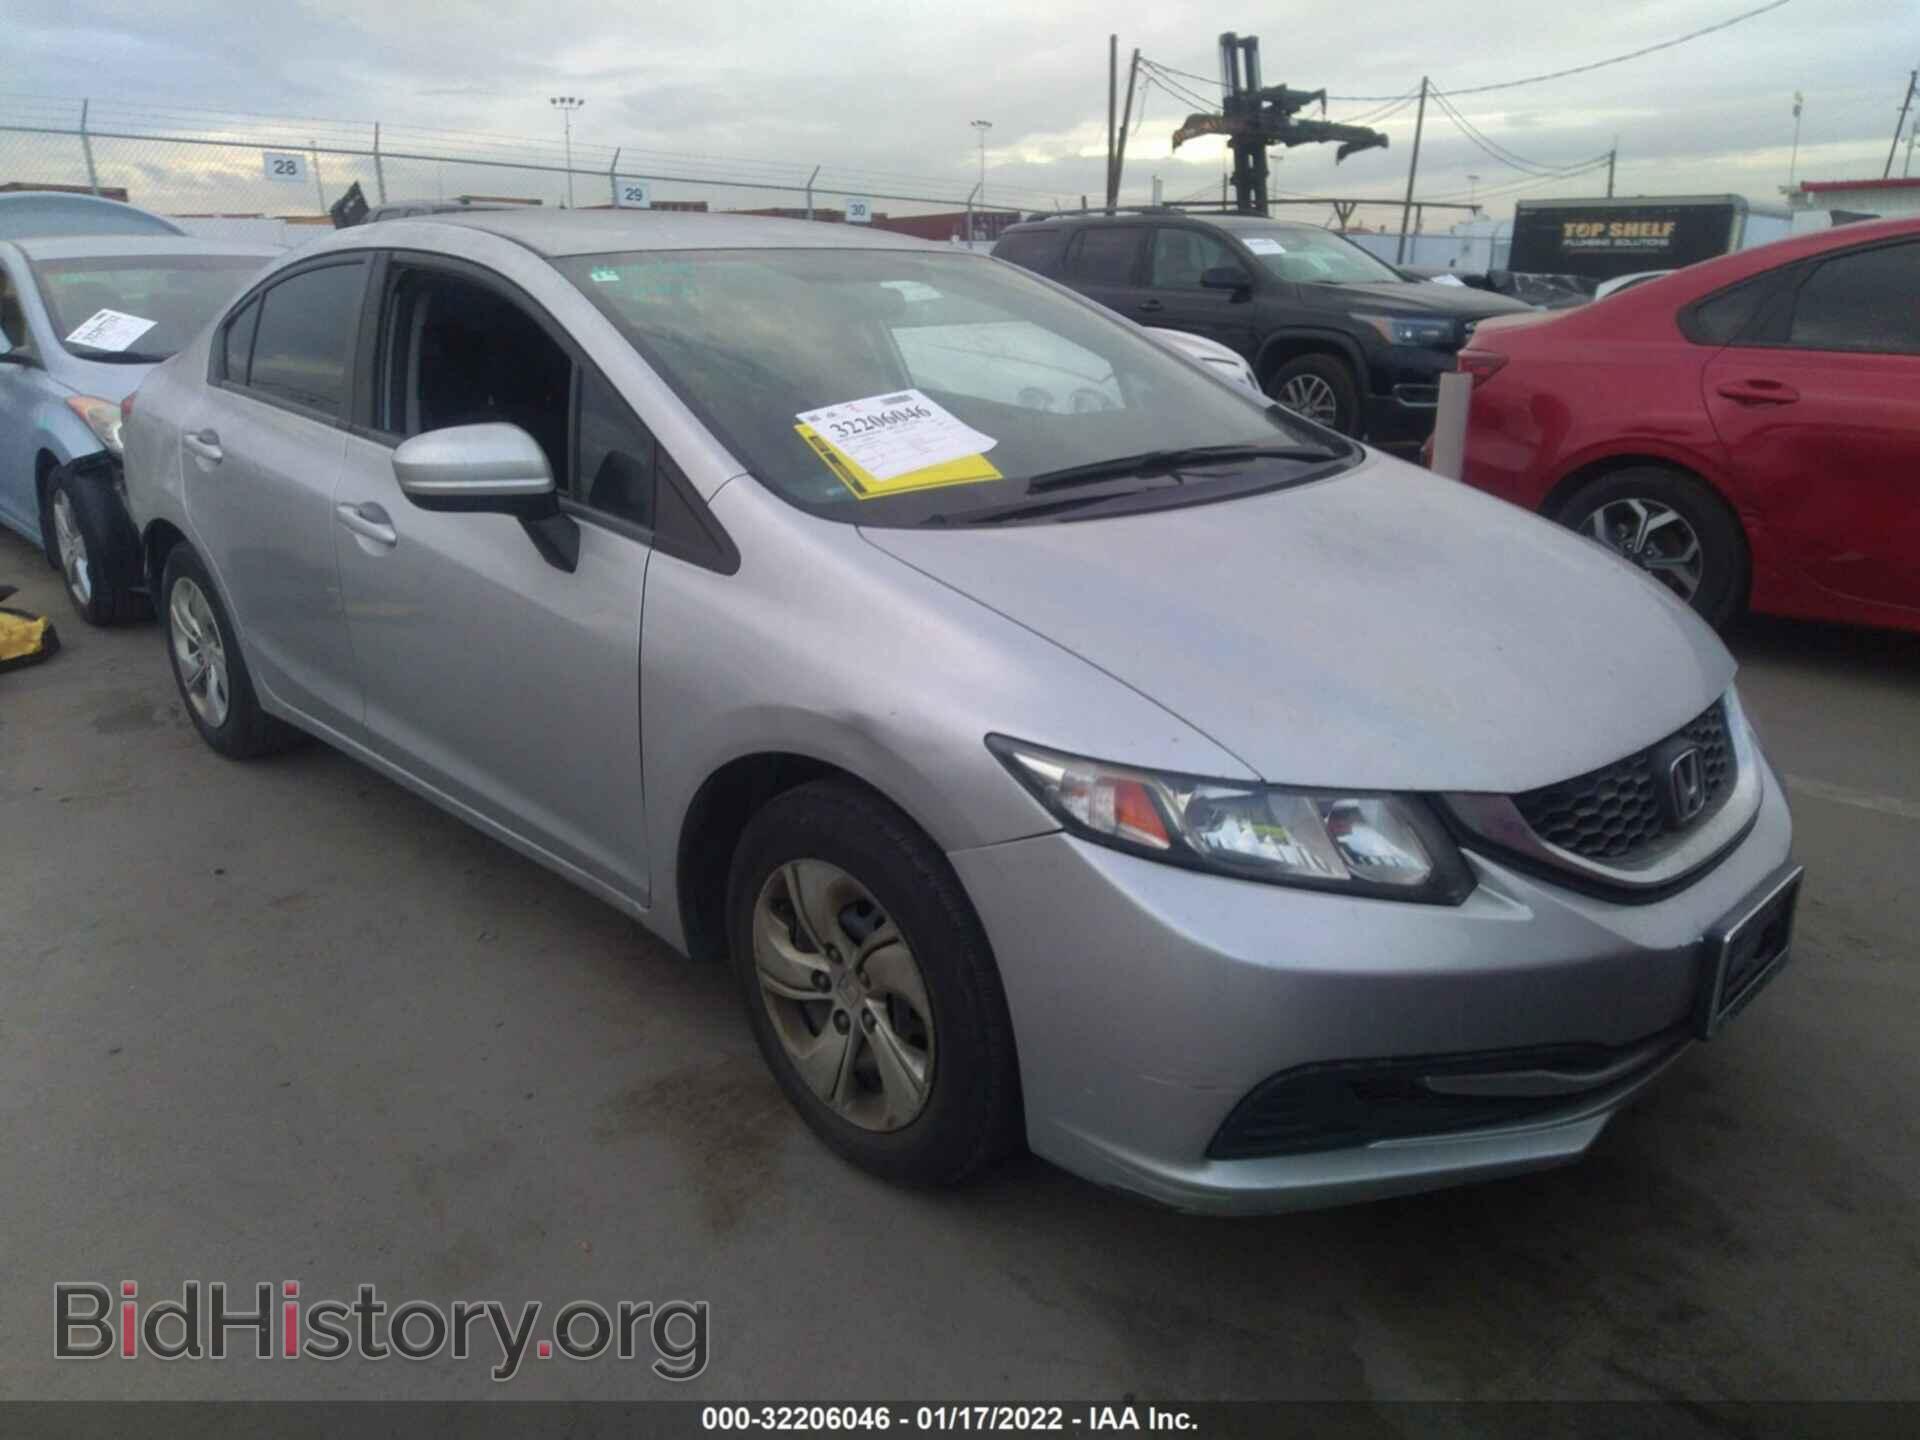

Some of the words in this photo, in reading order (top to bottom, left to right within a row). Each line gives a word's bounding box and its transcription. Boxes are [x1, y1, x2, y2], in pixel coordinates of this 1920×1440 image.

[273, 159, 297, 175] 28
[624, 187, 643, 202] 29
[850, 203, 866, 216] 30
[1563, 222, 1605, 237] TOP
[1609, 221, 1676, 237] SHELF
[829, 405, 932, 438] 32206046
